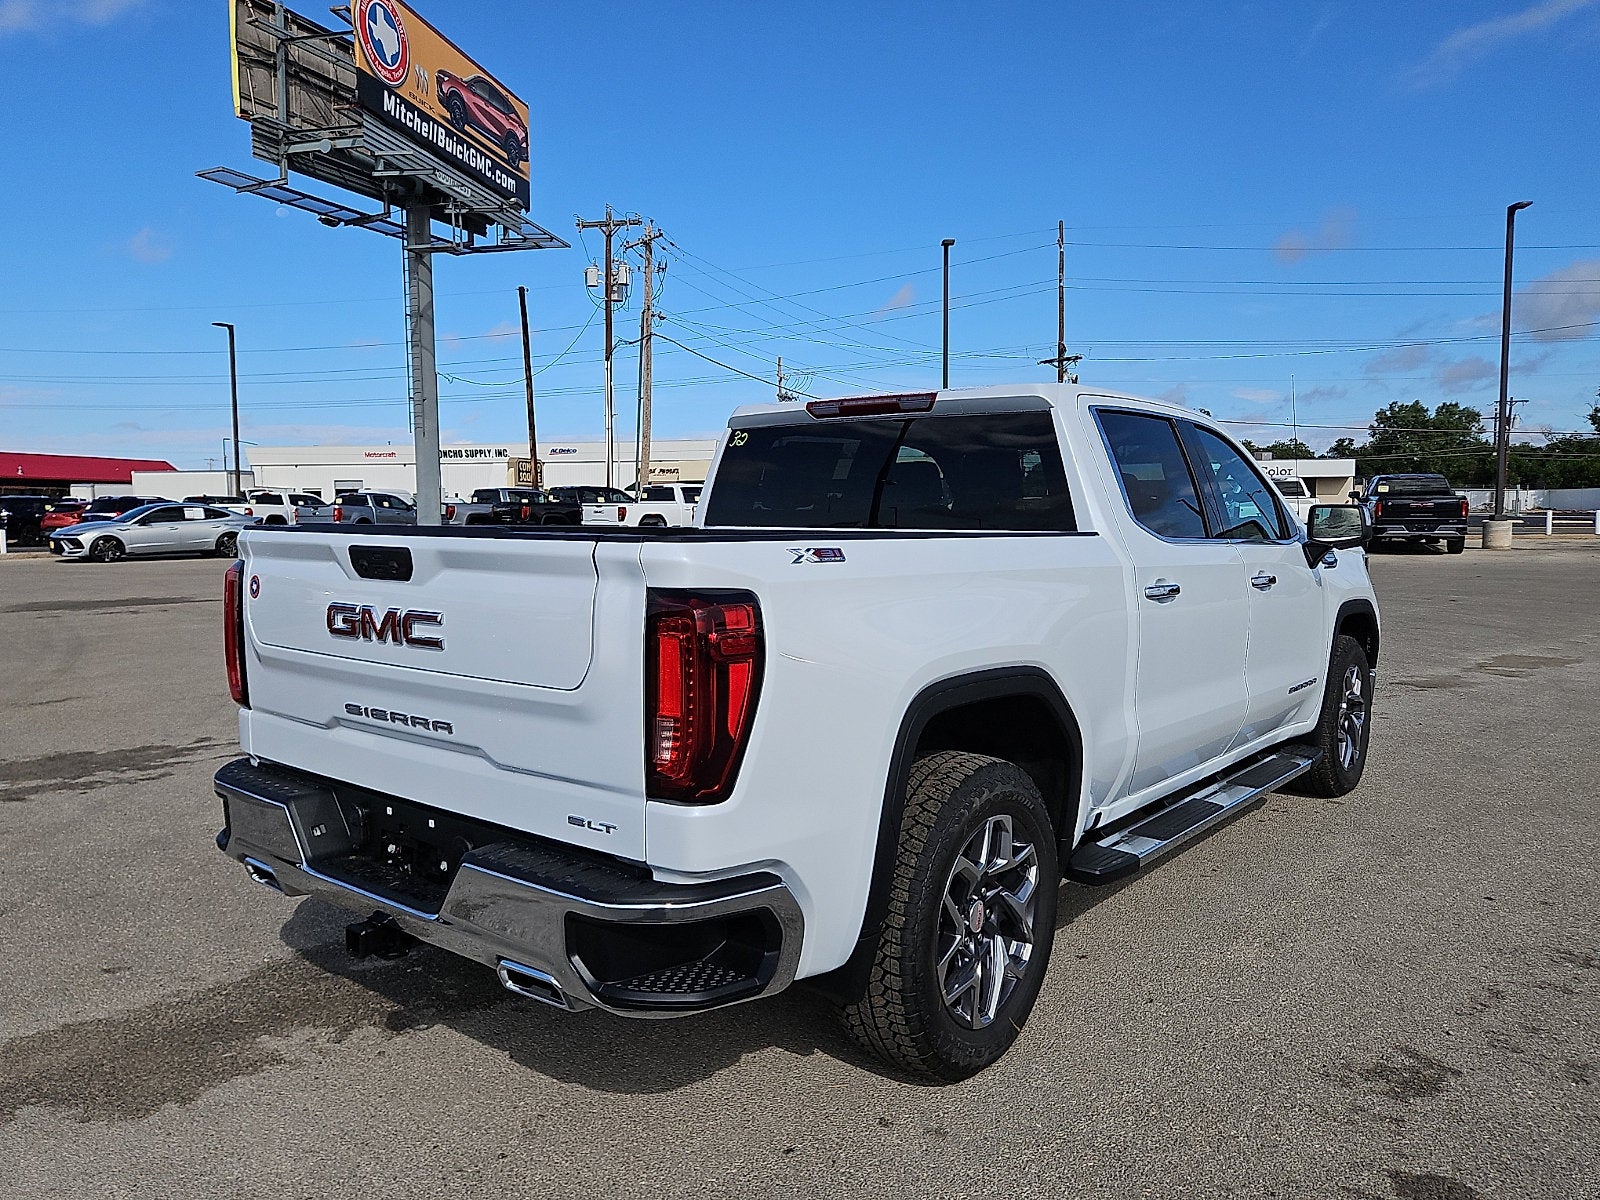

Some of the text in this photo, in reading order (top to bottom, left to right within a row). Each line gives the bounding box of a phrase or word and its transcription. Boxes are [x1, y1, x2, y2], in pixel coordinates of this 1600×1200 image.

[408, 91, 436, 115] BUICK
[383, 89, 516, 194] MitchellBuickGMC.com
[729, 430, 748, 447] 32
[439, 448, 510, 459] ONCHO SUPPLY, INC.
[519, 461, 541, 472] CONO
[519, 471, 541, 482] SQUE
[326, 601, 446, 652] GMC
[344, 702, 454, 735] SIERRA
[567, 815, 619, 835] SLT
